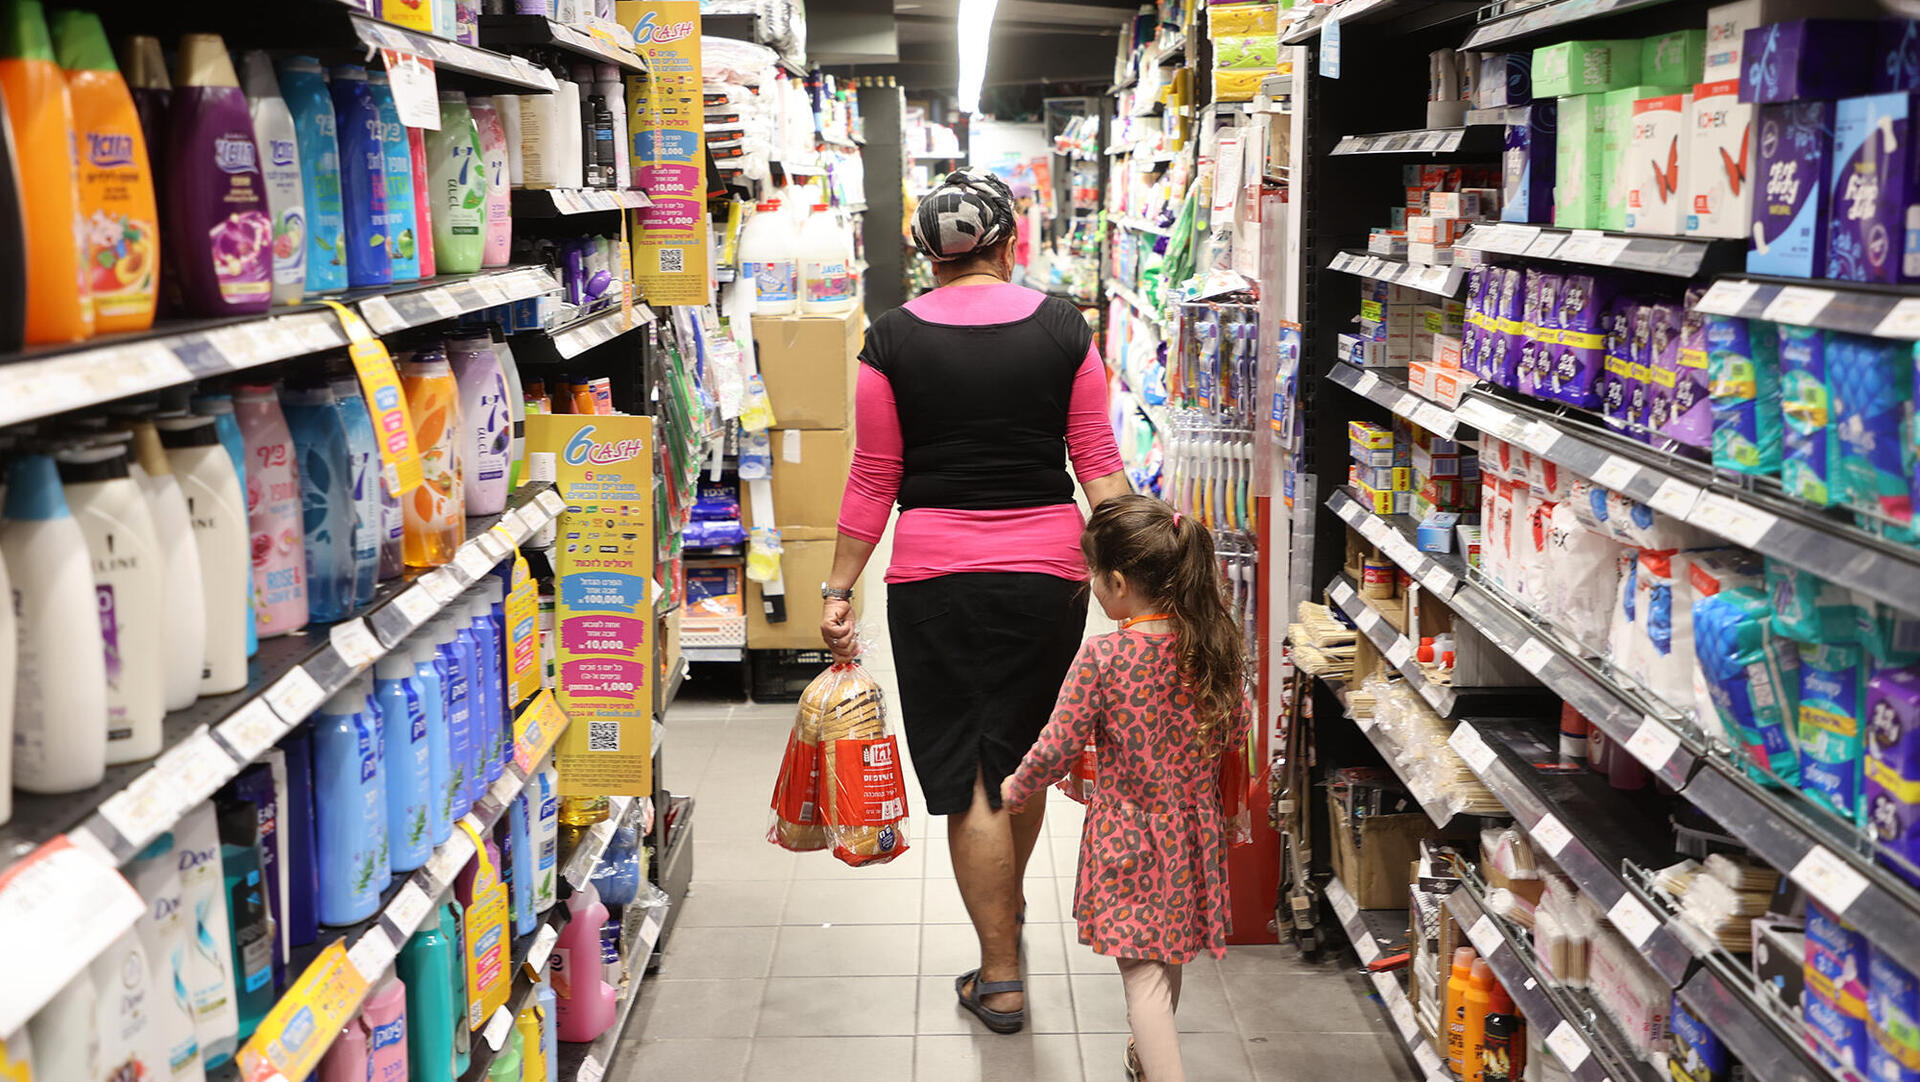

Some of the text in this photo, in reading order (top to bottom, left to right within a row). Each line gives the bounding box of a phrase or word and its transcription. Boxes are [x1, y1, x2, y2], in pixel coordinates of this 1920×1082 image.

[648, 48, 656, 57] 6
[821, 264, 845, 273] JAVEL
[564, 425, 643, 466] 6CASH
[585, 471, 593, 481] 6
[603, 559, 633, 567] ויכולים
[584, 594, 624, 604] 100,000
[585, 640, 624, 649] 10,000
[601, 682, 634, 691] 1,000
[178, 848, 216, 872] Dove
